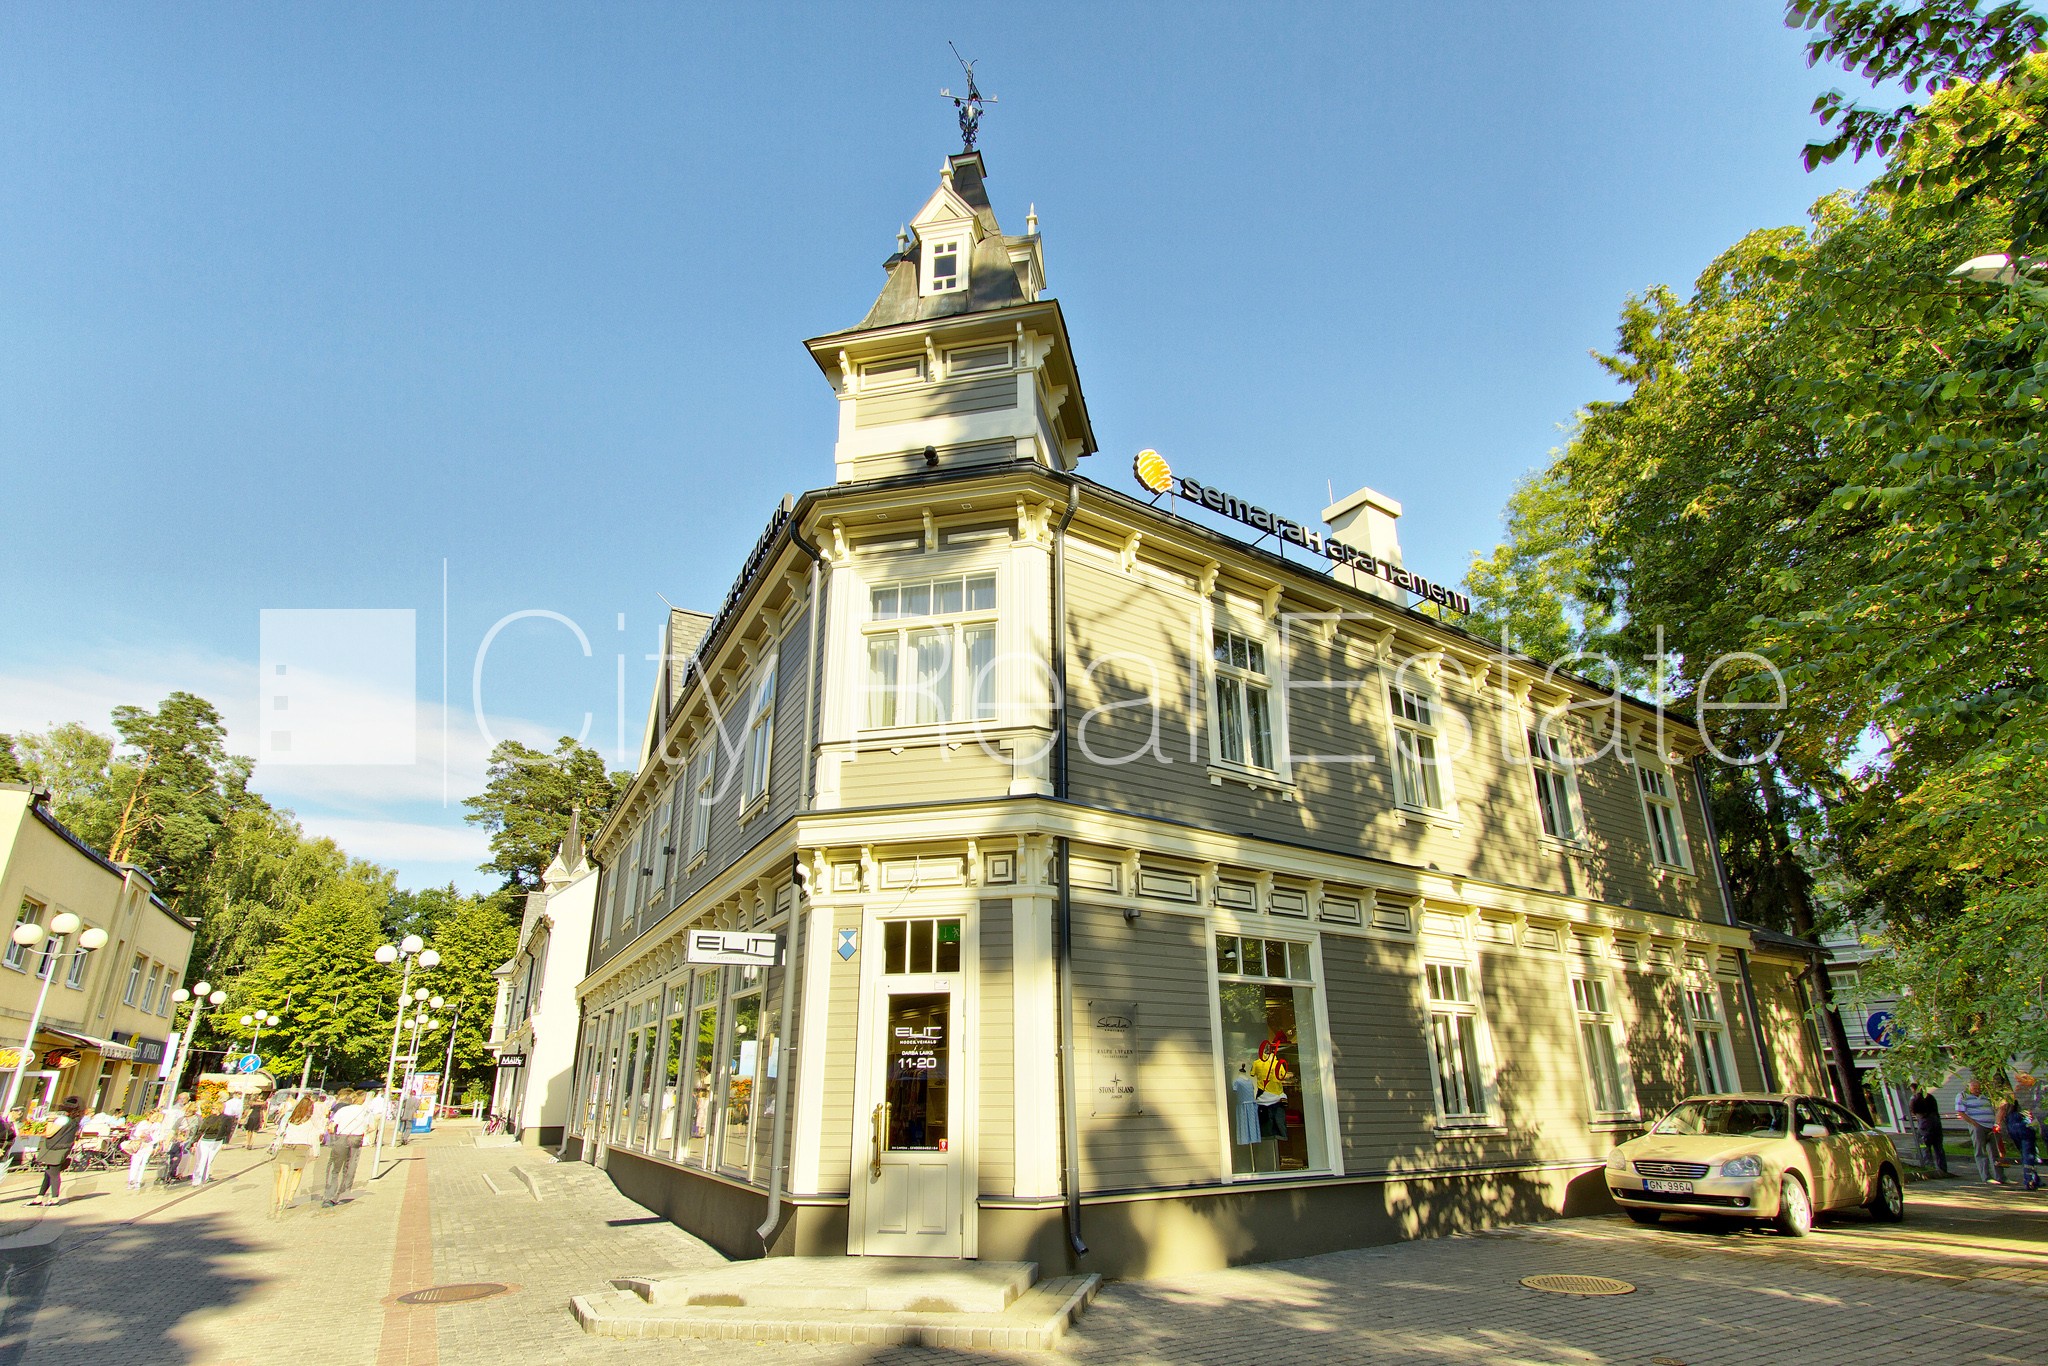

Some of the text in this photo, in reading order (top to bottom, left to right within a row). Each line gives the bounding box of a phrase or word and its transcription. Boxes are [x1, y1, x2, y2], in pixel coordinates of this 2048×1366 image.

[697, 936, 776, 953] ELIT
[896, 1026, 942, 1036] ELIT
[898, 1057, 937, 1069] 11-20
